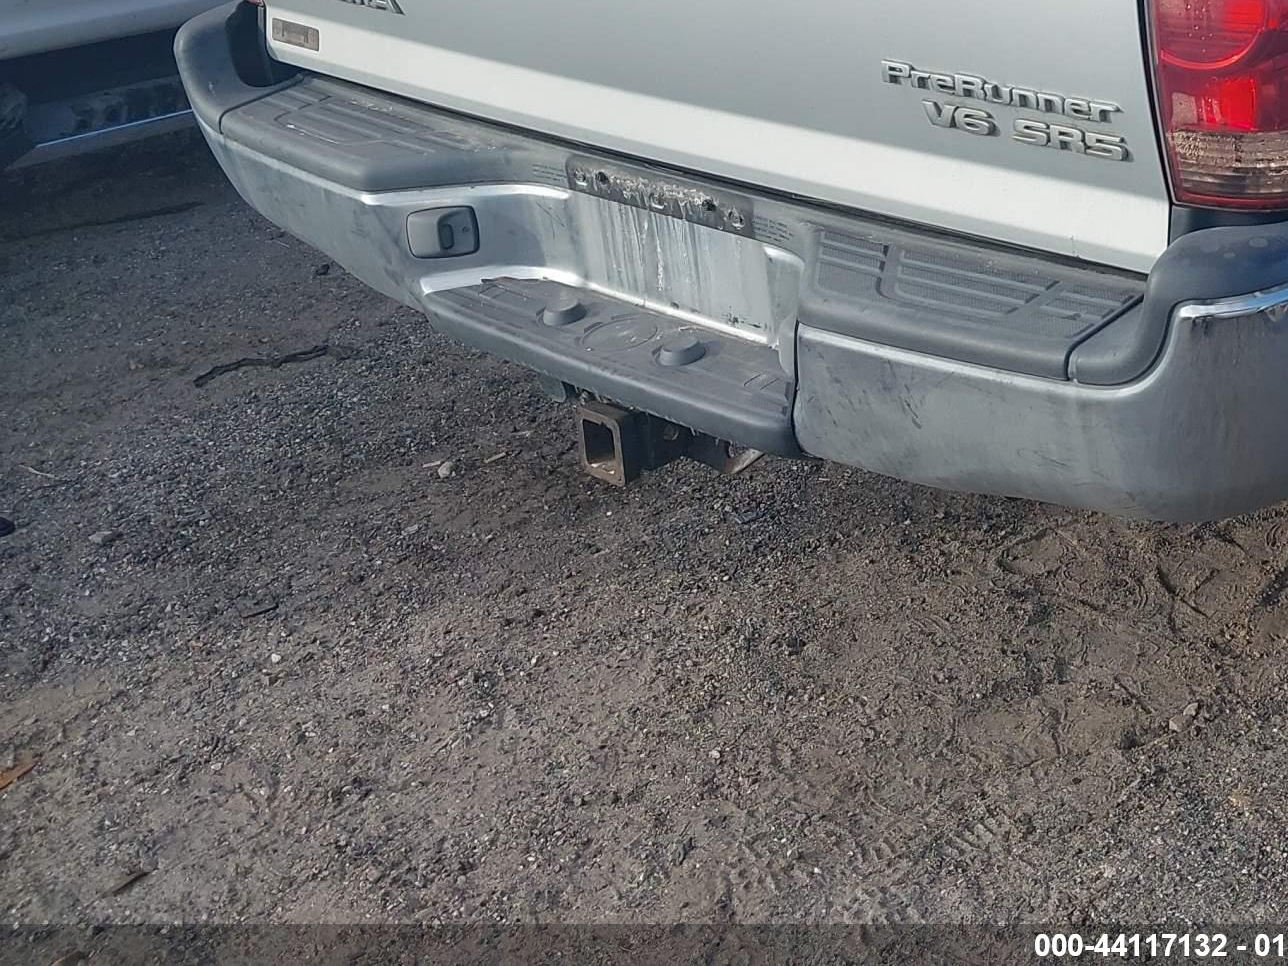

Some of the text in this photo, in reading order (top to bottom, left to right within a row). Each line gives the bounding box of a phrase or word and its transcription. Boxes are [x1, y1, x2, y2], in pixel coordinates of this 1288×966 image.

[880, 58, 1126, 124] PreRunner
[921, 98, 1135, 163] V6 SR5
